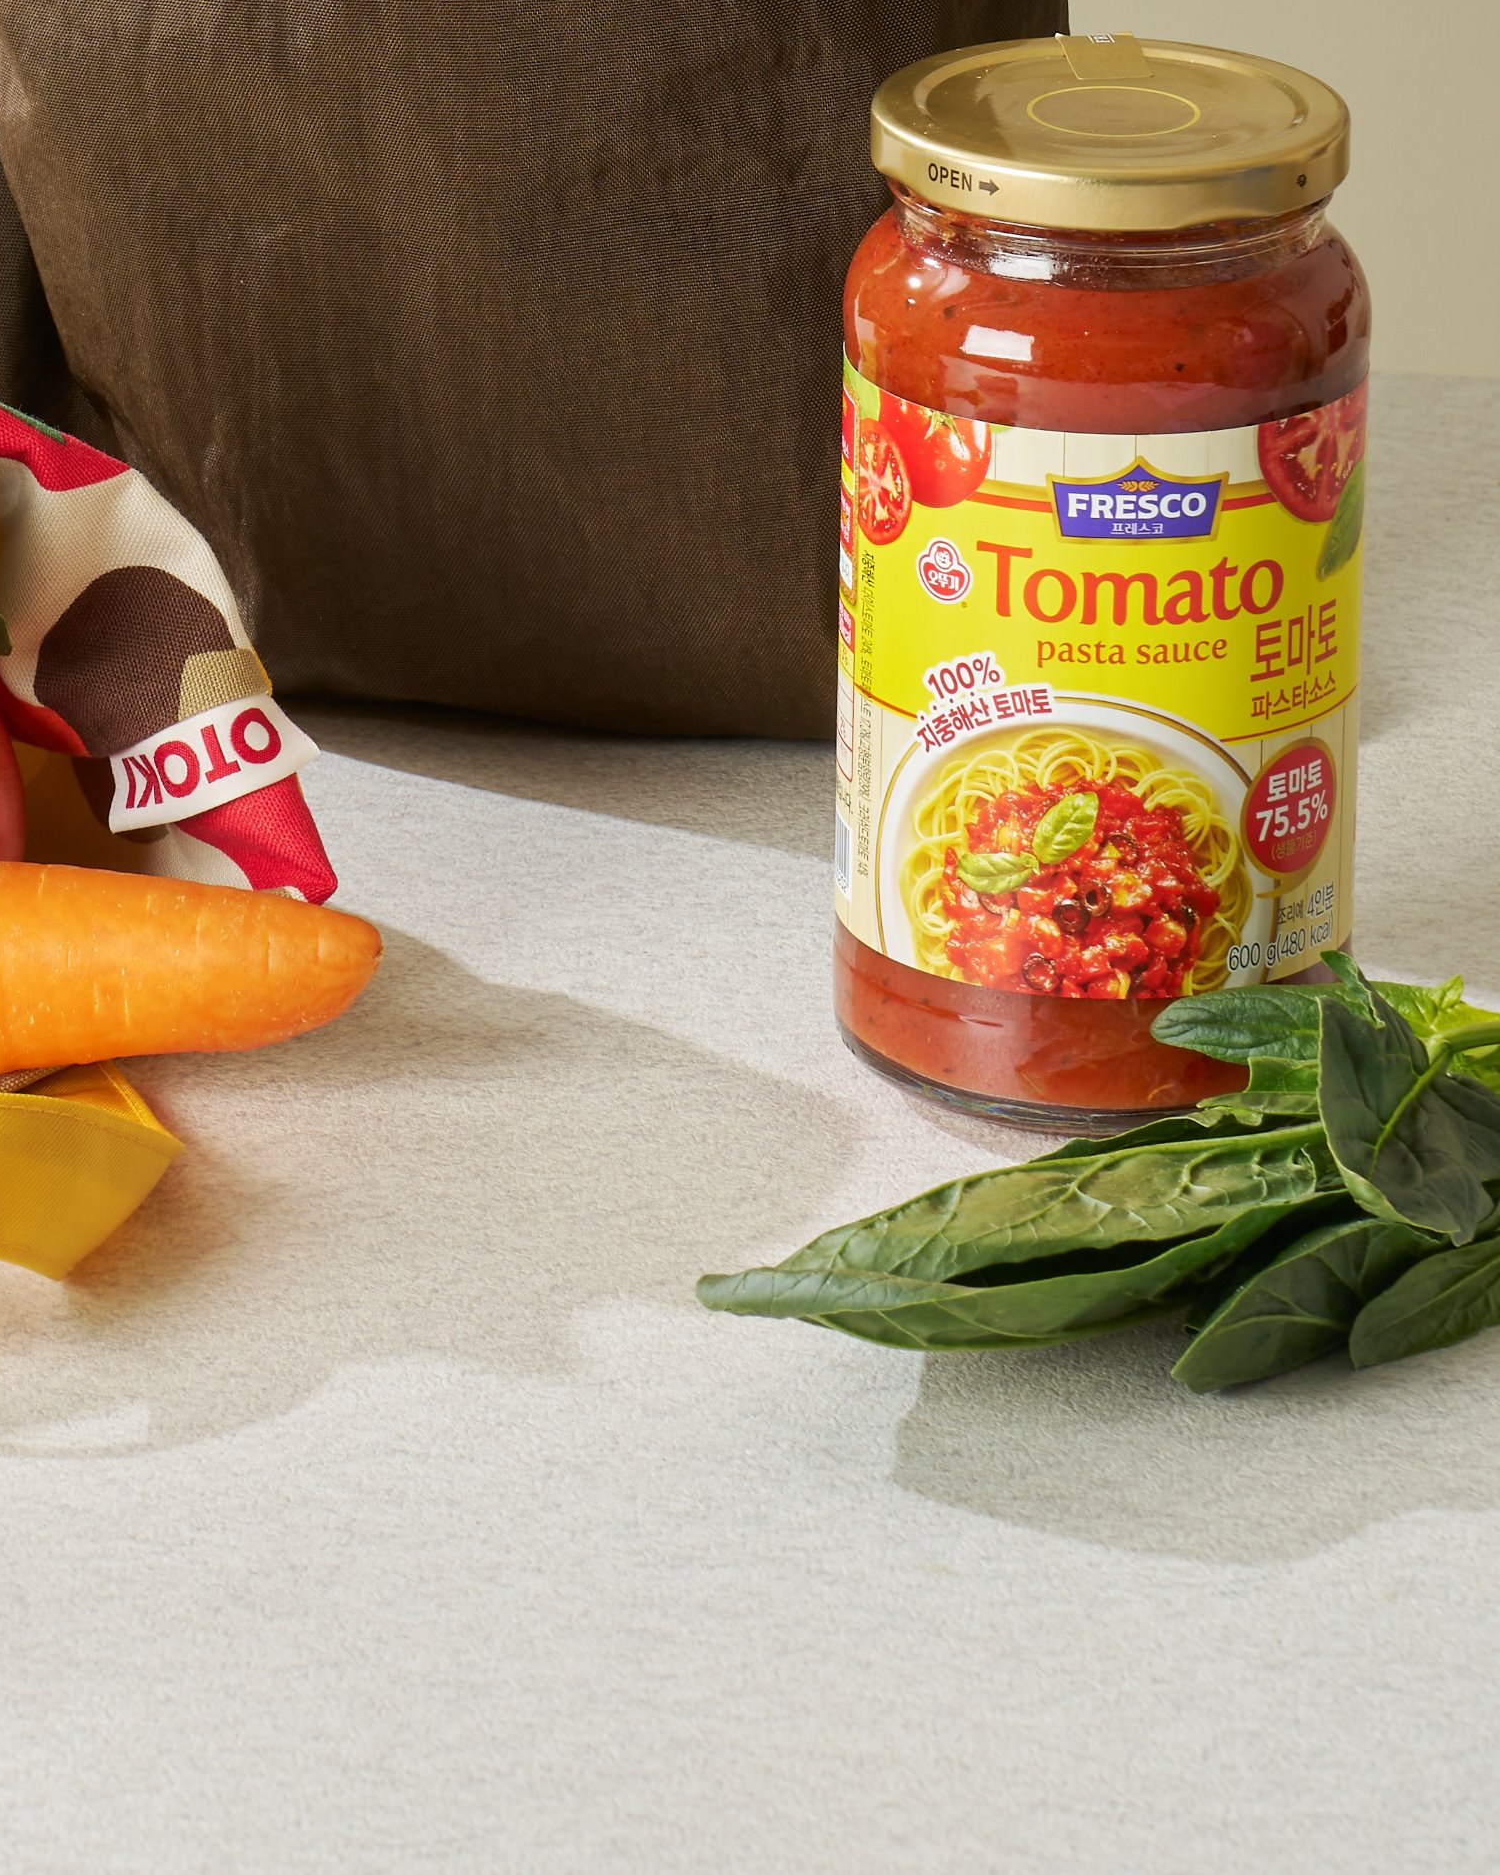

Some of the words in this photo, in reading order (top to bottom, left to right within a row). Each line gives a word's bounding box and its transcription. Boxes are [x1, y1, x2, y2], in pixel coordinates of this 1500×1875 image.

[928, 162, 972, 192] OPEN
[1067, 492, 1207, 519] FRESCO
[1110, 522, 1164, 535] 프레스코
[928, 570, 959, 592] 오뚜기
[976, 540, 1284, 626] Tomato
[1037, 639, 1126, 668] pasta
[1136, 638, 1228, 665] sauce
[1250, 598, 1338, 682] 토마토
[928, 657, 1000, 700] 100%
[1251, 670, 1336, 721] 파스타소스
[917, 696, 993, 753] 지중해산
[993, 688, 1052, 721] 토마토
[121, 707, 282, 810] OTOKI
[1267, 758, 1323, 803] 토마토
[1256, 789, 1328, 842] 75.5%
[1271, 830, 1317, 860] (생물기준)
[1278, 898, 1304, 925] 조리예
[1307, 881, 1334, 917] 4인분
[1229, 942, 1261, 971] 600
[1310, 910, 1334, 946] kcal)
